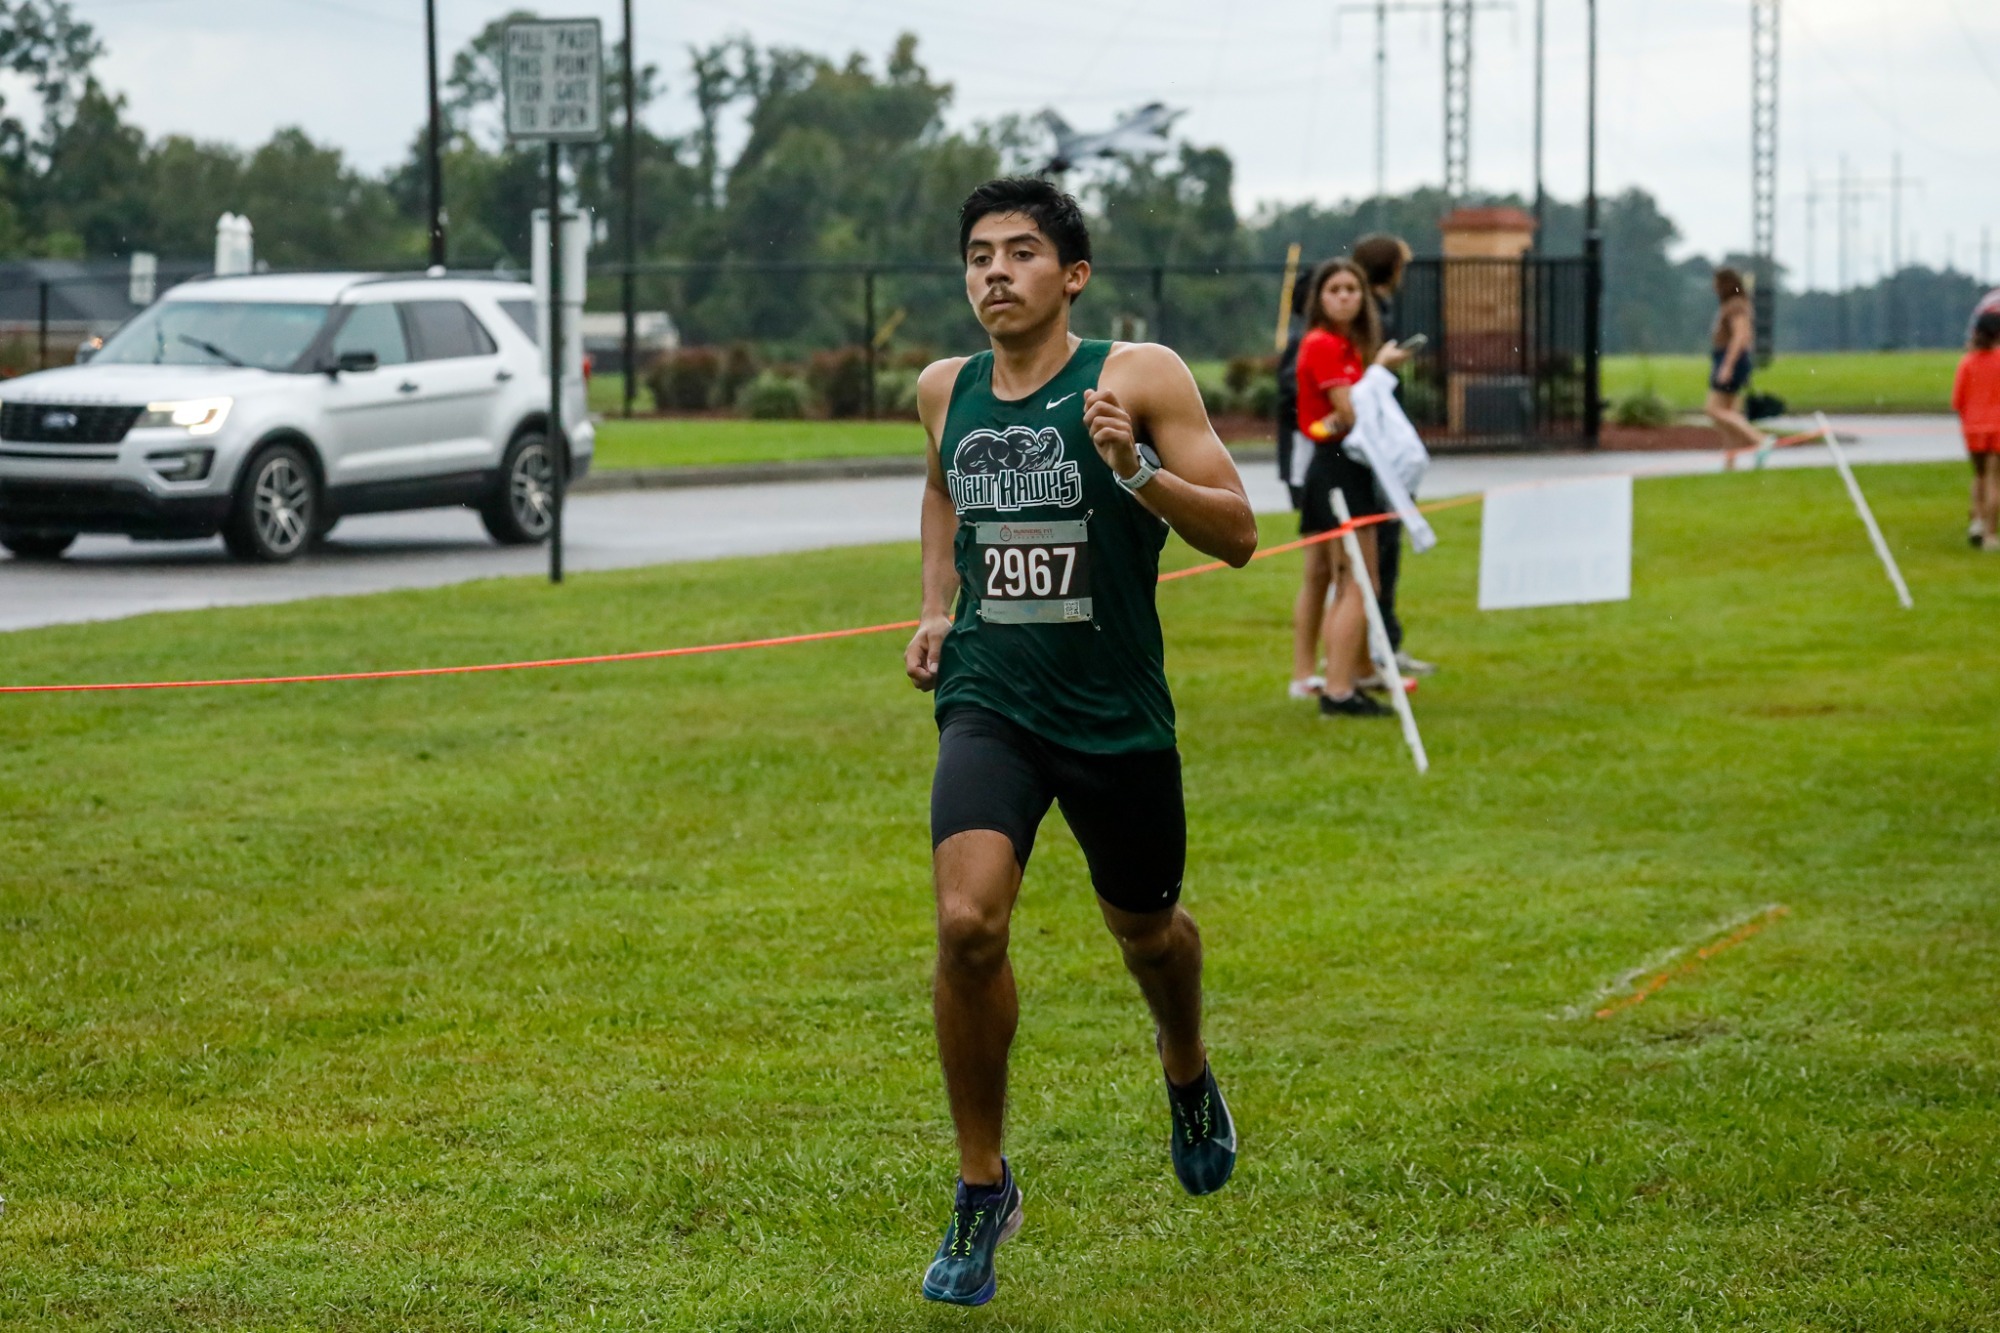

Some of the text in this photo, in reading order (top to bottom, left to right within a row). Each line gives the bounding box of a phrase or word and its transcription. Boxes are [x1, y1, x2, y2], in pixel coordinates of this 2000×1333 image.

[947, 460, 1082, 515] NIGHT HAWKS
[985, 547, 1076, 597] 2967
